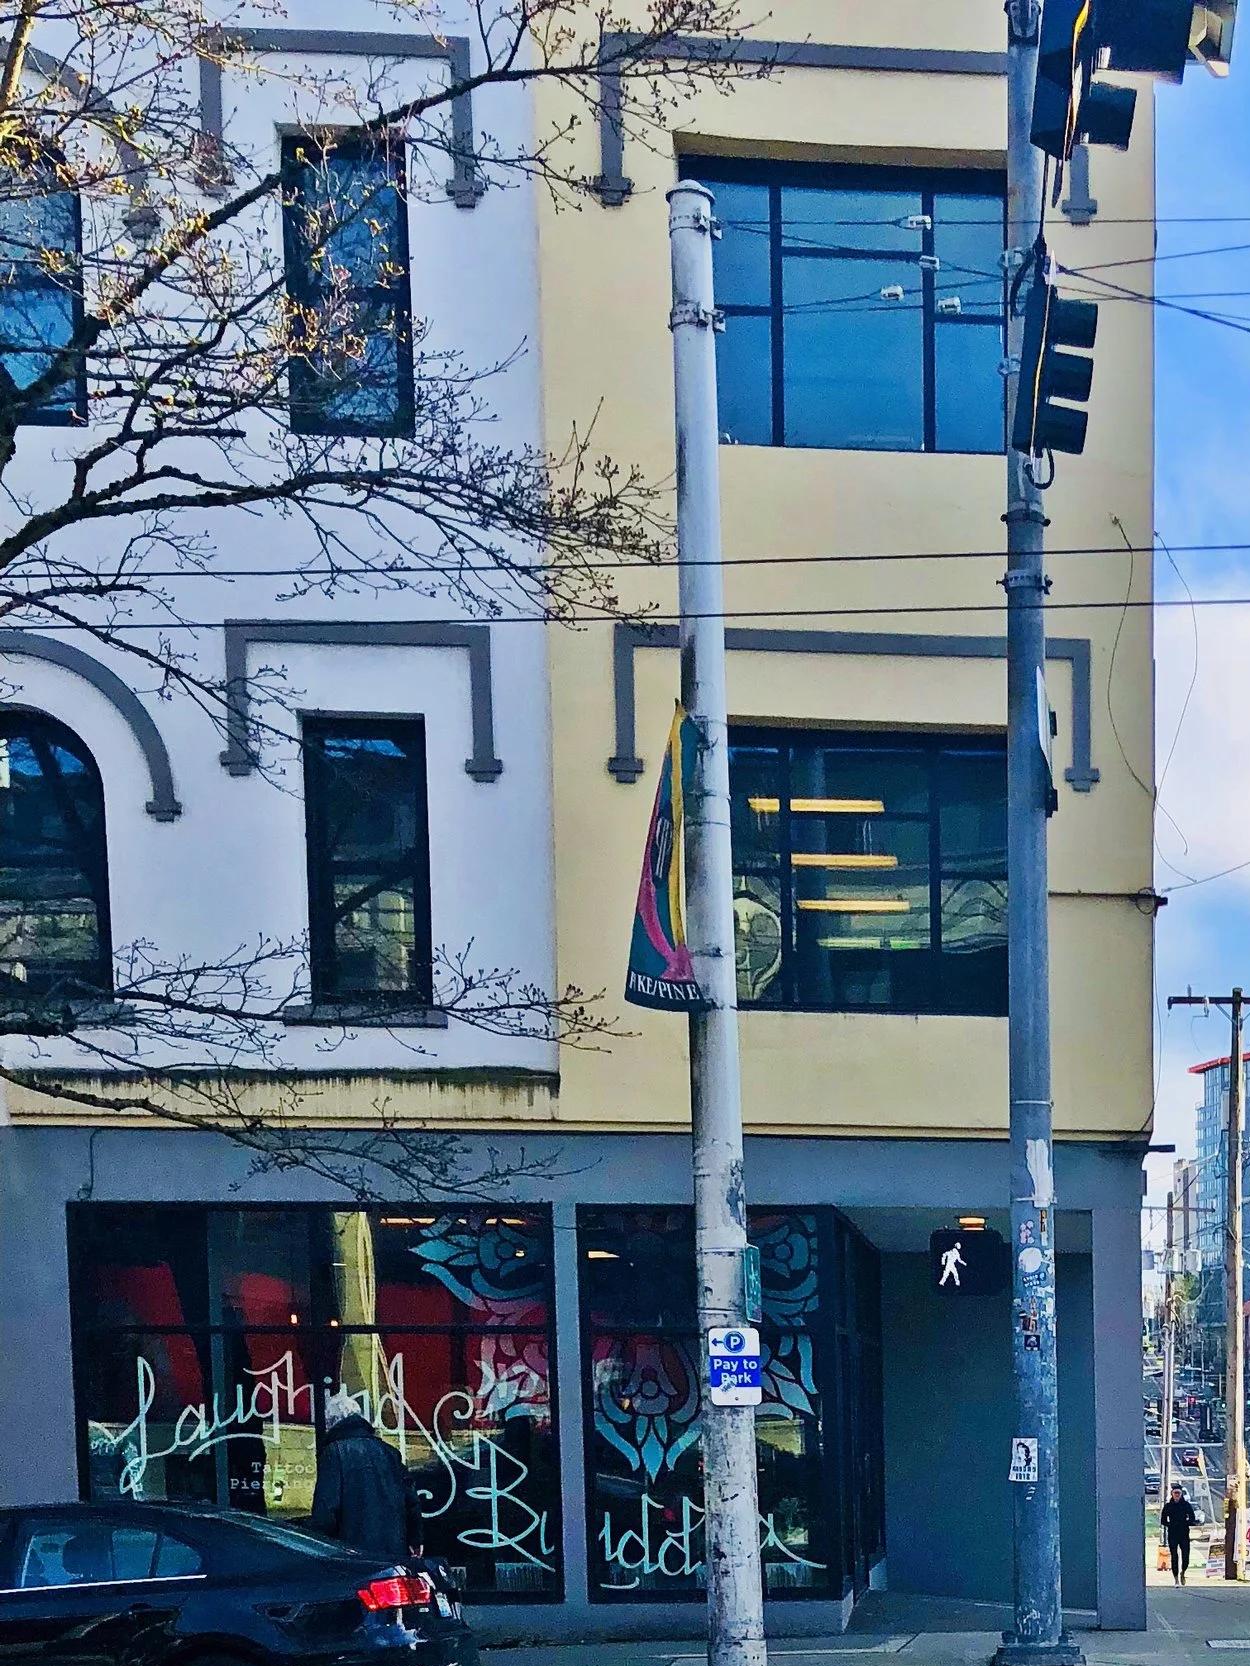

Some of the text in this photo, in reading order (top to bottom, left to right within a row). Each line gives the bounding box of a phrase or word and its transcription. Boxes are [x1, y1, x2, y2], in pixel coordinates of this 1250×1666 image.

[713, 1359, 758, 1372] Pay to
[721, 1372, 752, 1384] Park
